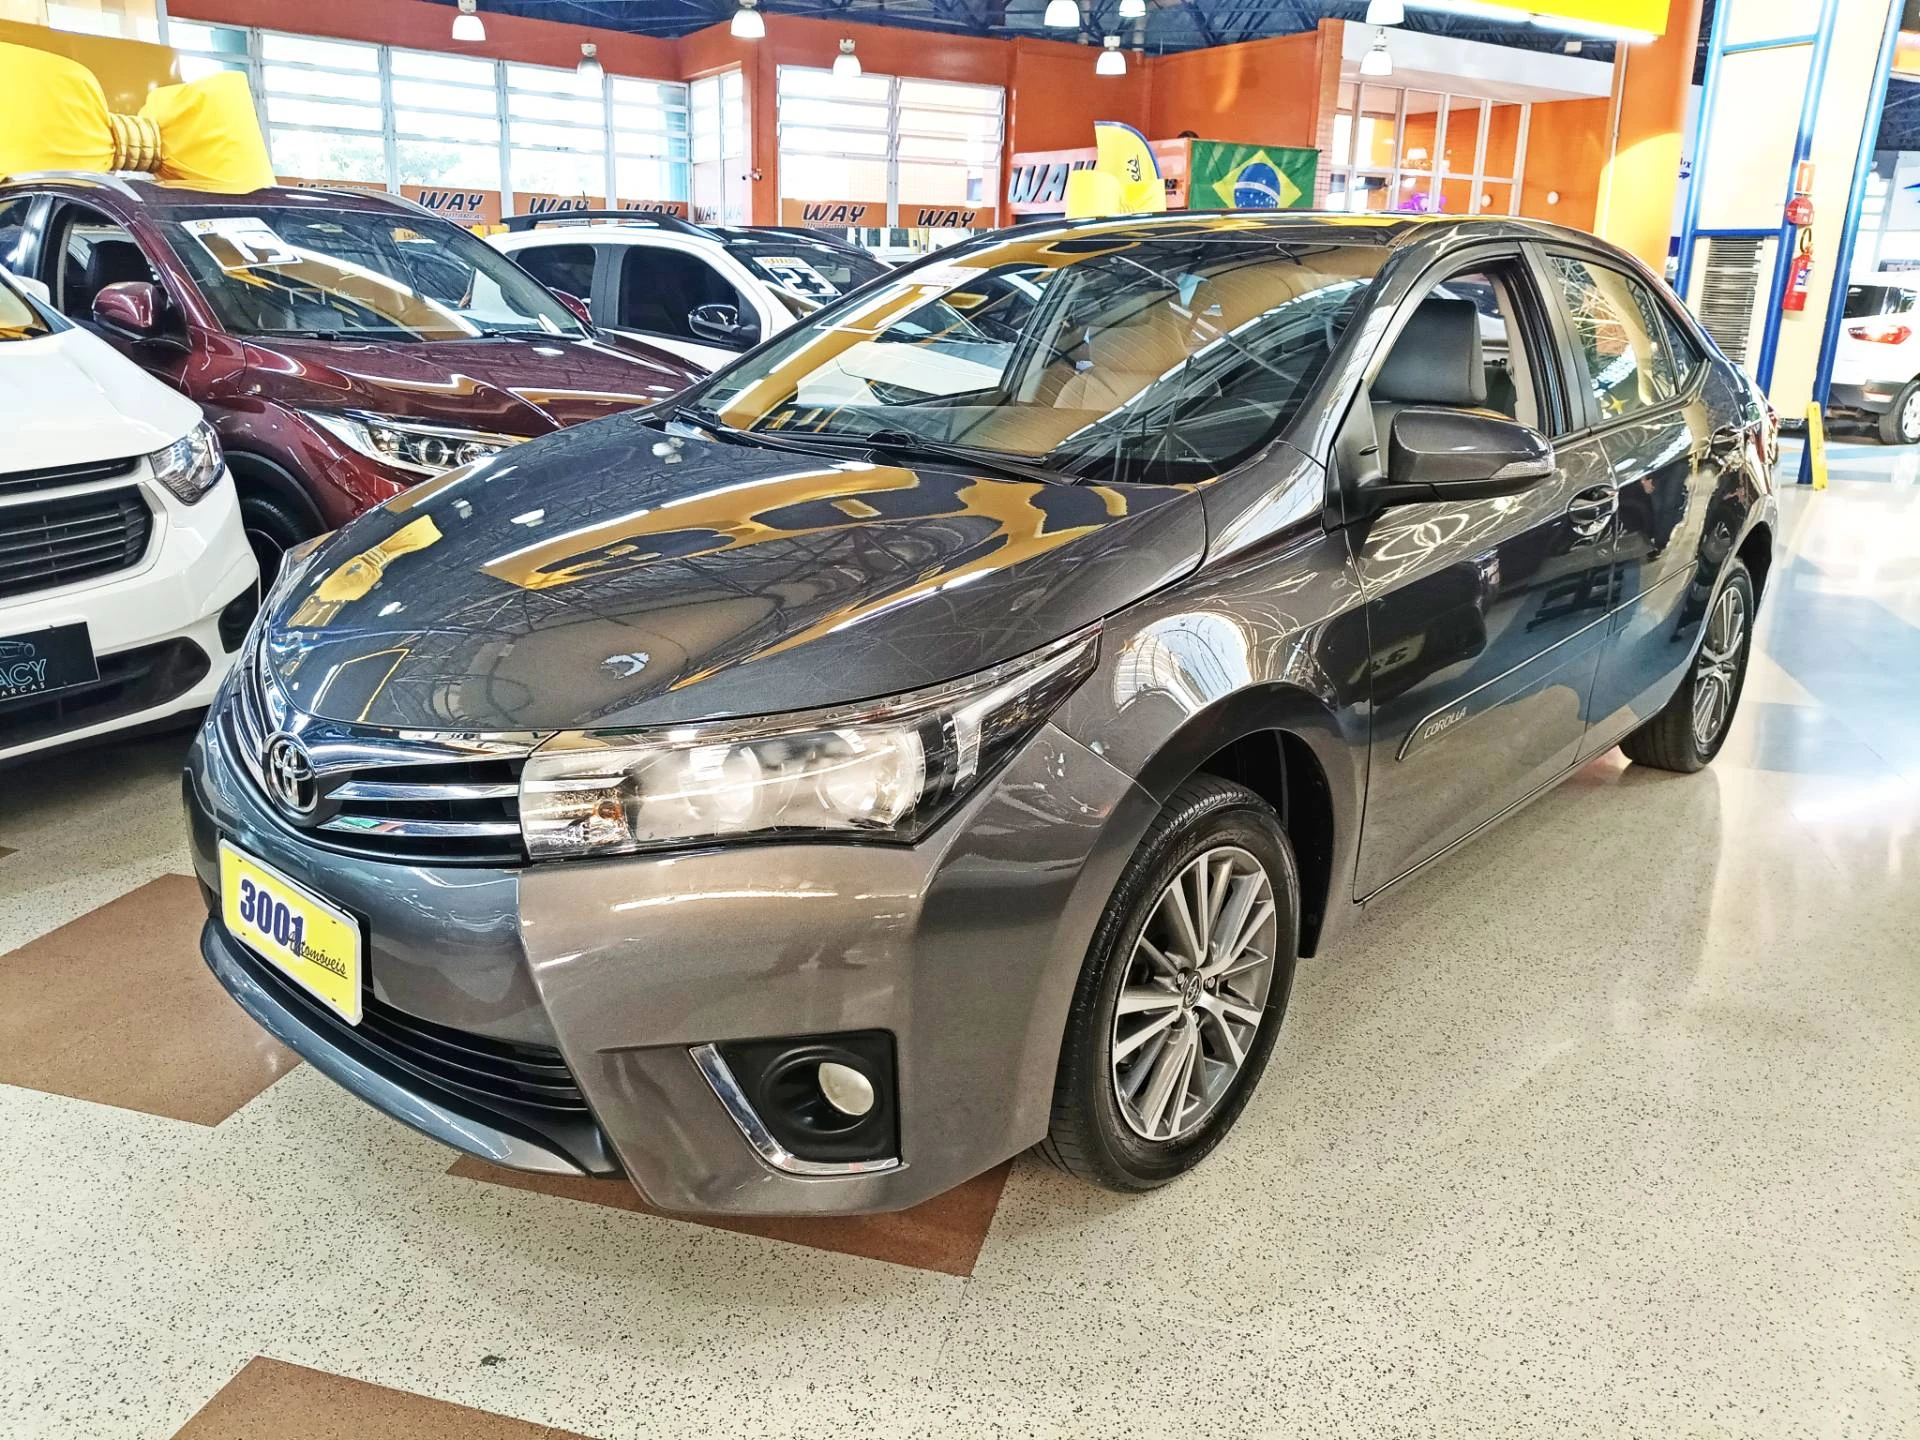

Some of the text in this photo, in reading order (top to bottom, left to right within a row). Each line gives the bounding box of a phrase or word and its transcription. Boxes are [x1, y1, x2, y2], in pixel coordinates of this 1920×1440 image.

[1008, 160, 1097, 202] WA
[419, 191, 484, 212] WAY
[802, 204, 867, 223] WAY
[917, 208, 977, 228] WAY
[771, 268, 837, 294] 23
[1423, 706, 1467, 740] COROLLA
[240, 878, 304, 958] 3001
